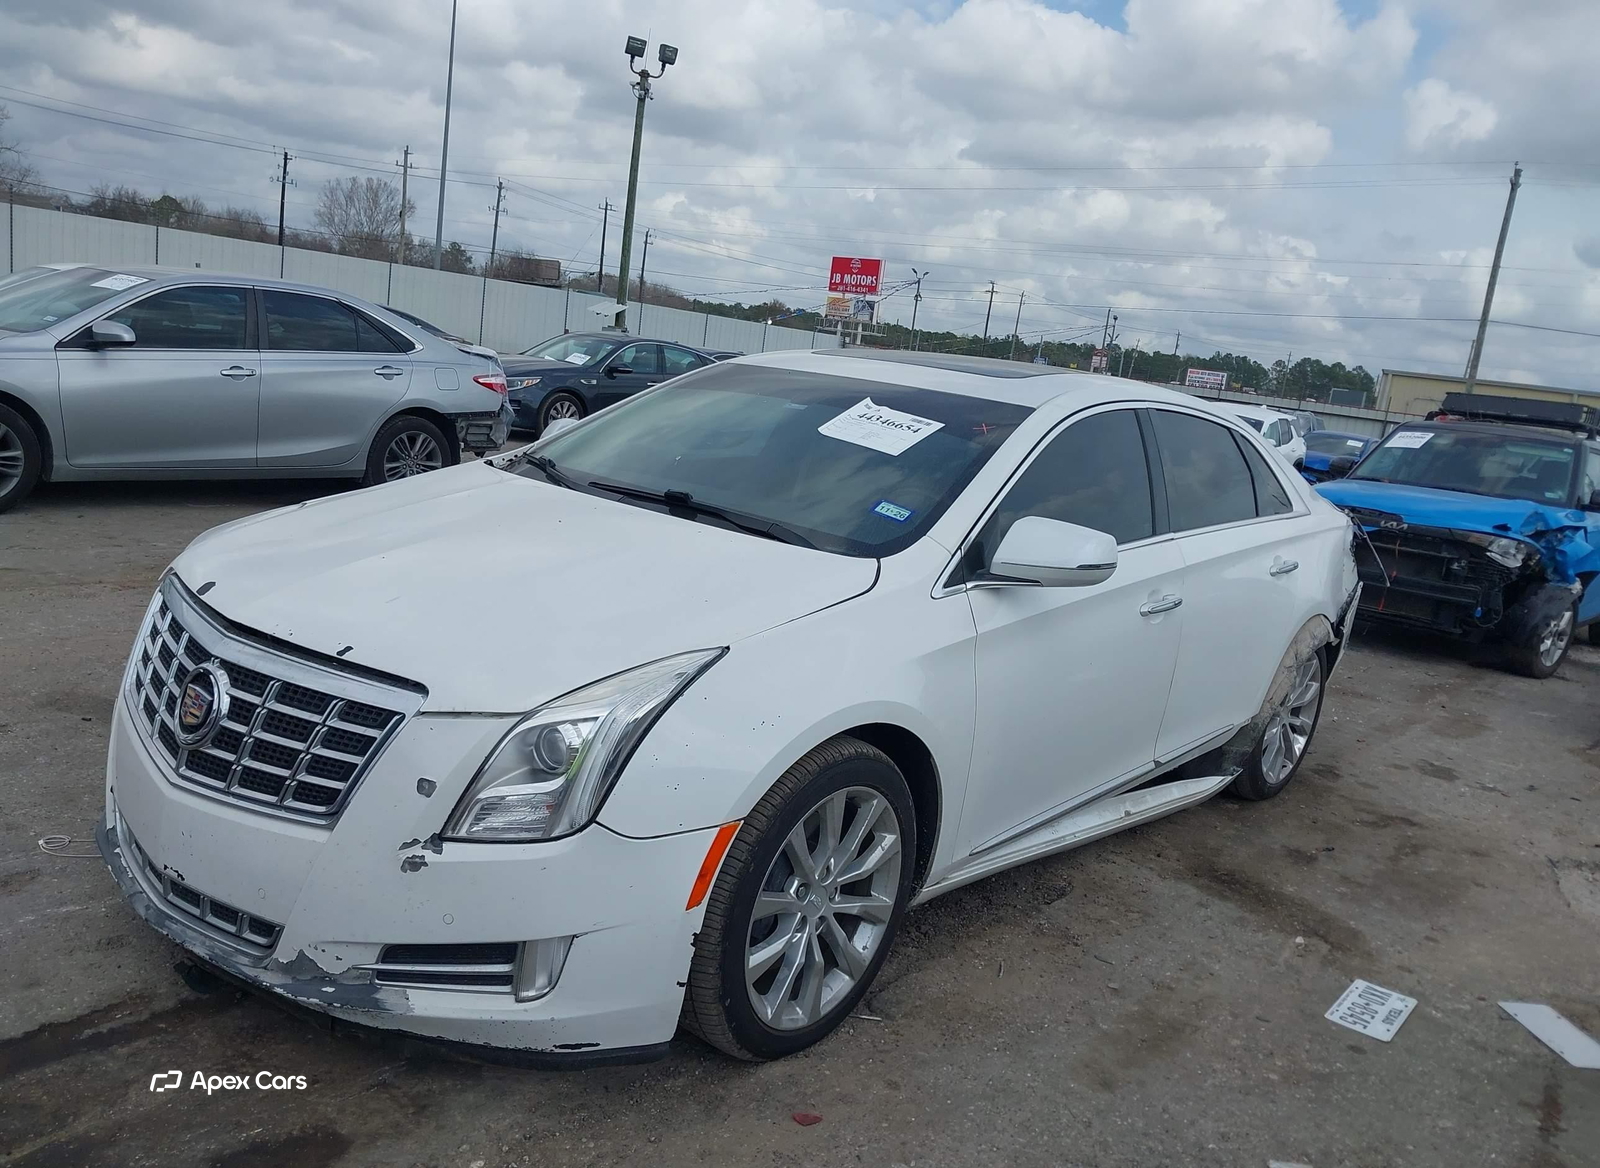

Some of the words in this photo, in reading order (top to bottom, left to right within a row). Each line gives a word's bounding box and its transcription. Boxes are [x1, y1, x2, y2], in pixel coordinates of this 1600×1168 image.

[831, 273, 841, 284] JB
[843, 274, 877, 286] MOTORS
[857, 412, 923, 434] 44346654
[1381, 1007, 1404, 1026] TEXAS
